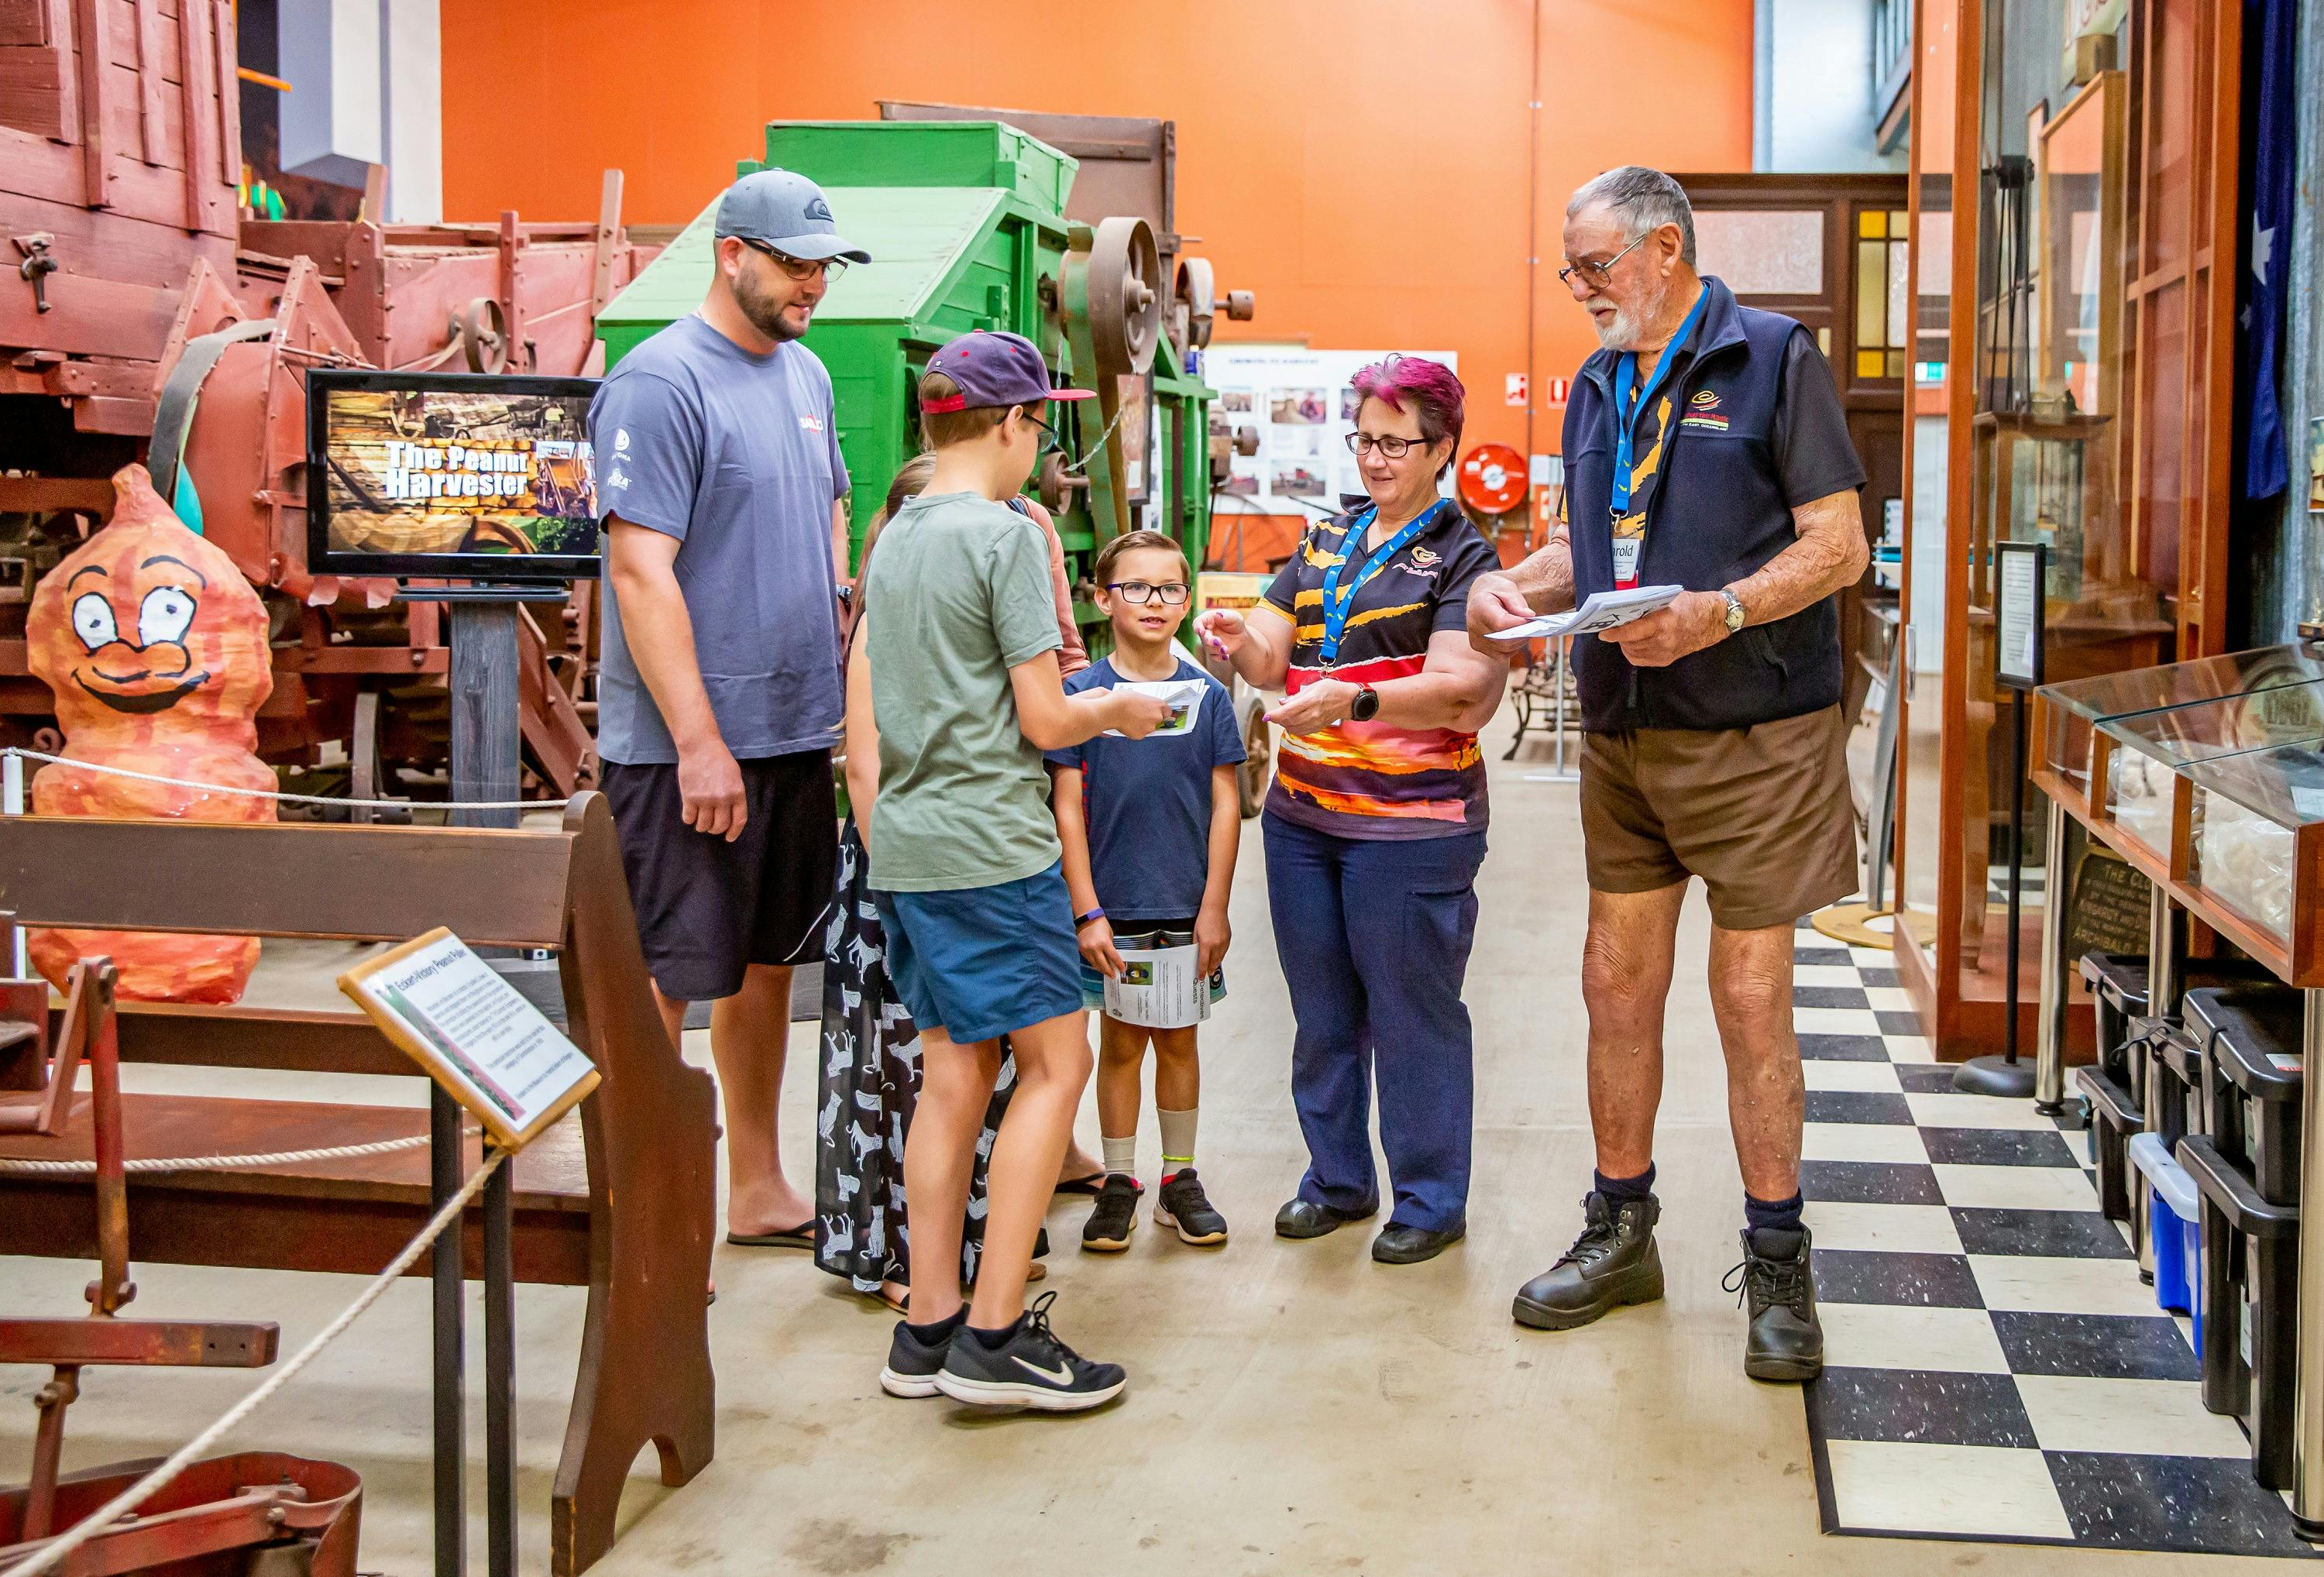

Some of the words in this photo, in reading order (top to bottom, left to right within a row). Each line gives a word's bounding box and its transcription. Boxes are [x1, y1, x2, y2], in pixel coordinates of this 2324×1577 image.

[385, 441, 442, 469] The
[449, 445, 528, 472] Peanut
[386, 468, 528, 498] Harvester
[1612, 545, 1634, 557] arold
